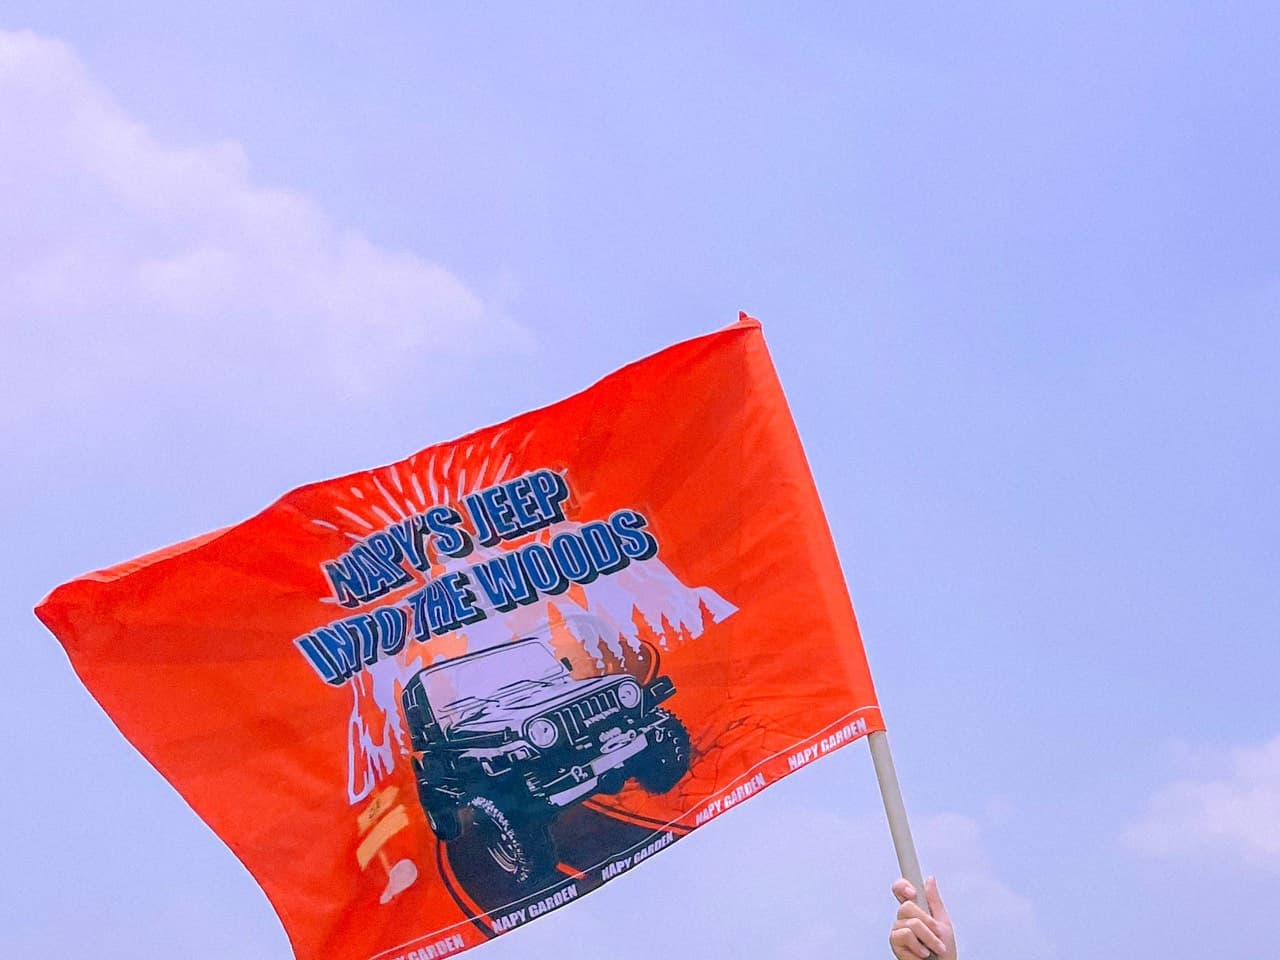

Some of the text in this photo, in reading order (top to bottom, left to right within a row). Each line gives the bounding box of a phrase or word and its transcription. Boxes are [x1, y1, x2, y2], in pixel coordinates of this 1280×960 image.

[325, 468, 571, 607] NAPY'S JEEP
[294, 508, 660, 687] INTO THE WOODS
[788, 717, 867, 771] NAPY GARDEN
[696, 772, 766, 825] NAPY GARDEN
[602, 830, 674, 881] NAPY GARDEN
[491, 884, 578, 934] NAPY GARDEN
